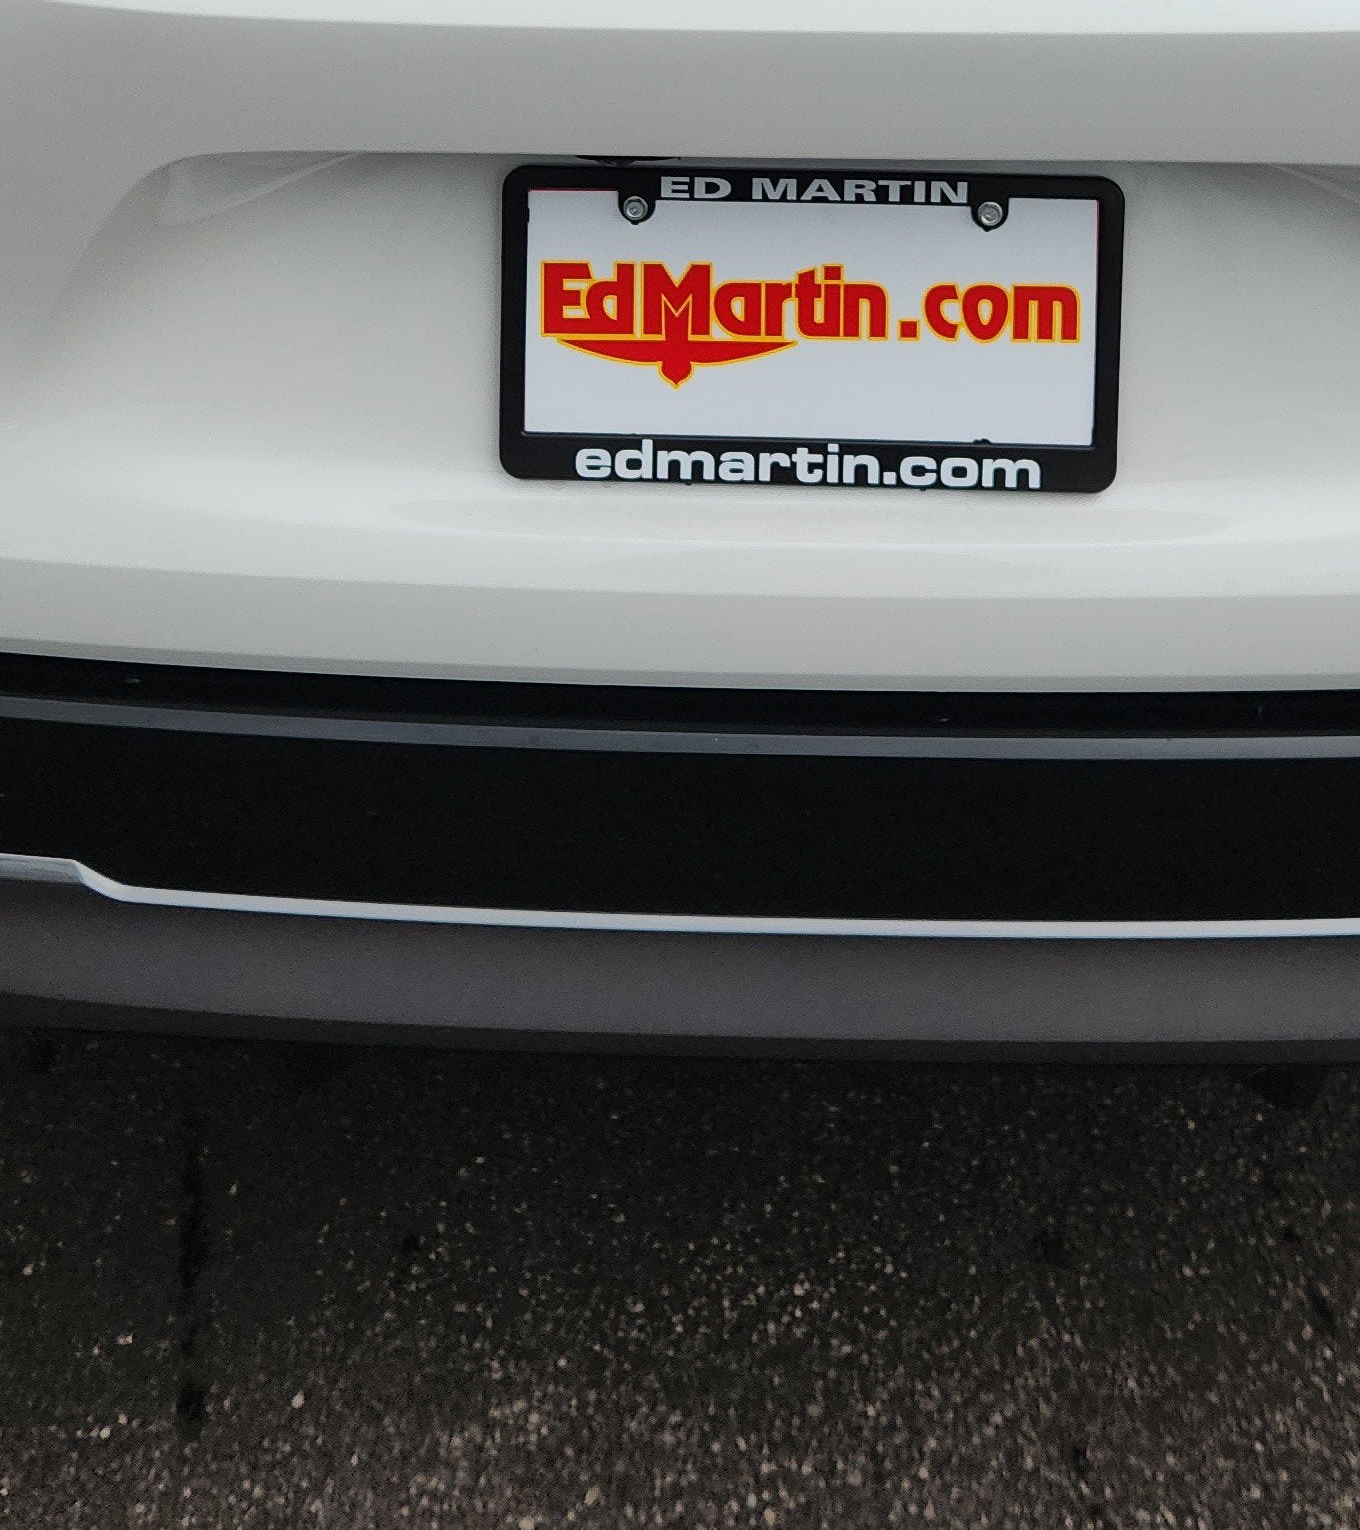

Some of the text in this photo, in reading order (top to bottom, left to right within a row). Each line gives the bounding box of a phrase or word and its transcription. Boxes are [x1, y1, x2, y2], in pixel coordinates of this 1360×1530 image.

[660, 176, 969, 204] ED MARTIN
[541, 261, 1081, 345] EdMartin.com
[575, 439, 1041, 490] edmartin.com
